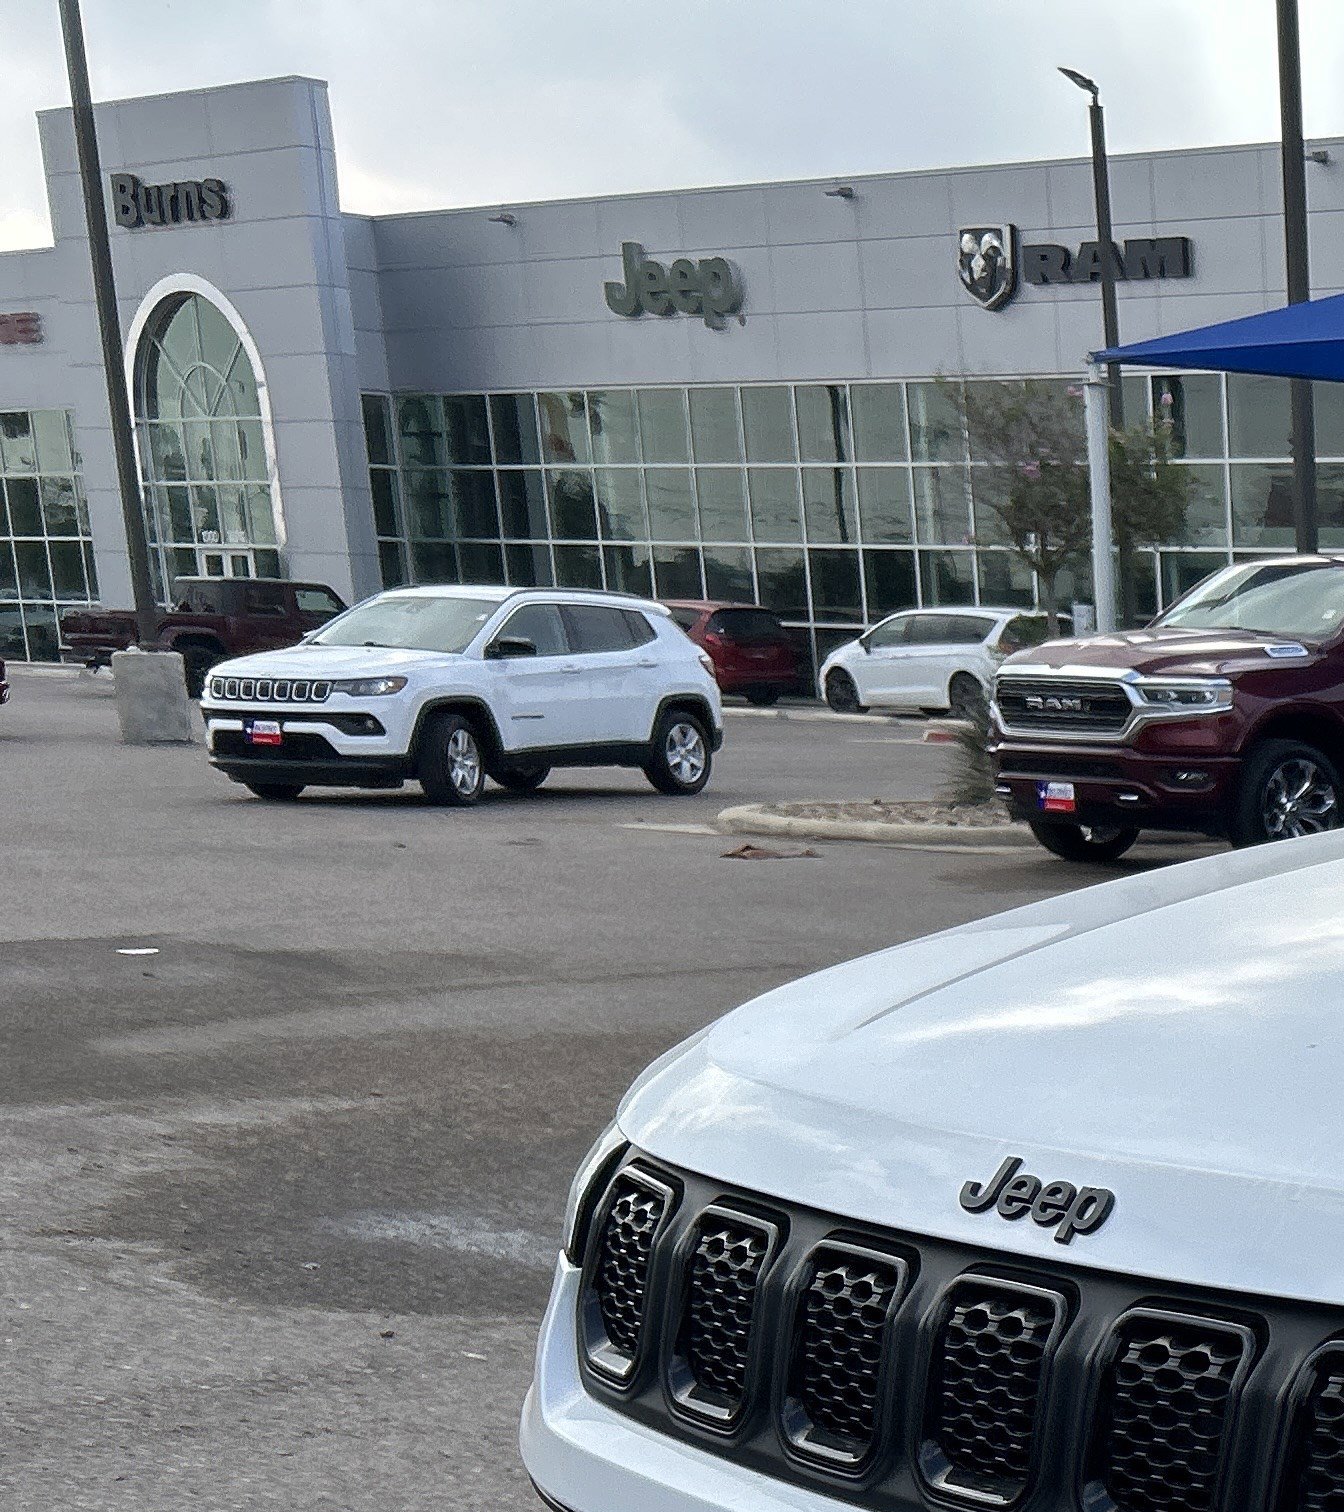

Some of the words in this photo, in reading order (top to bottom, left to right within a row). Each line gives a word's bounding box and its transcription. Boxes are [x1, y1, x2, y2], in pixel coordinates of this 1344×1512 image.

[110, 173, 231, 228] Burns
[603, 241, 741, 331] Jeep
[1022, 237, 1190, 284] RAM
[959, 1156, 1115, 1245] Jeep
